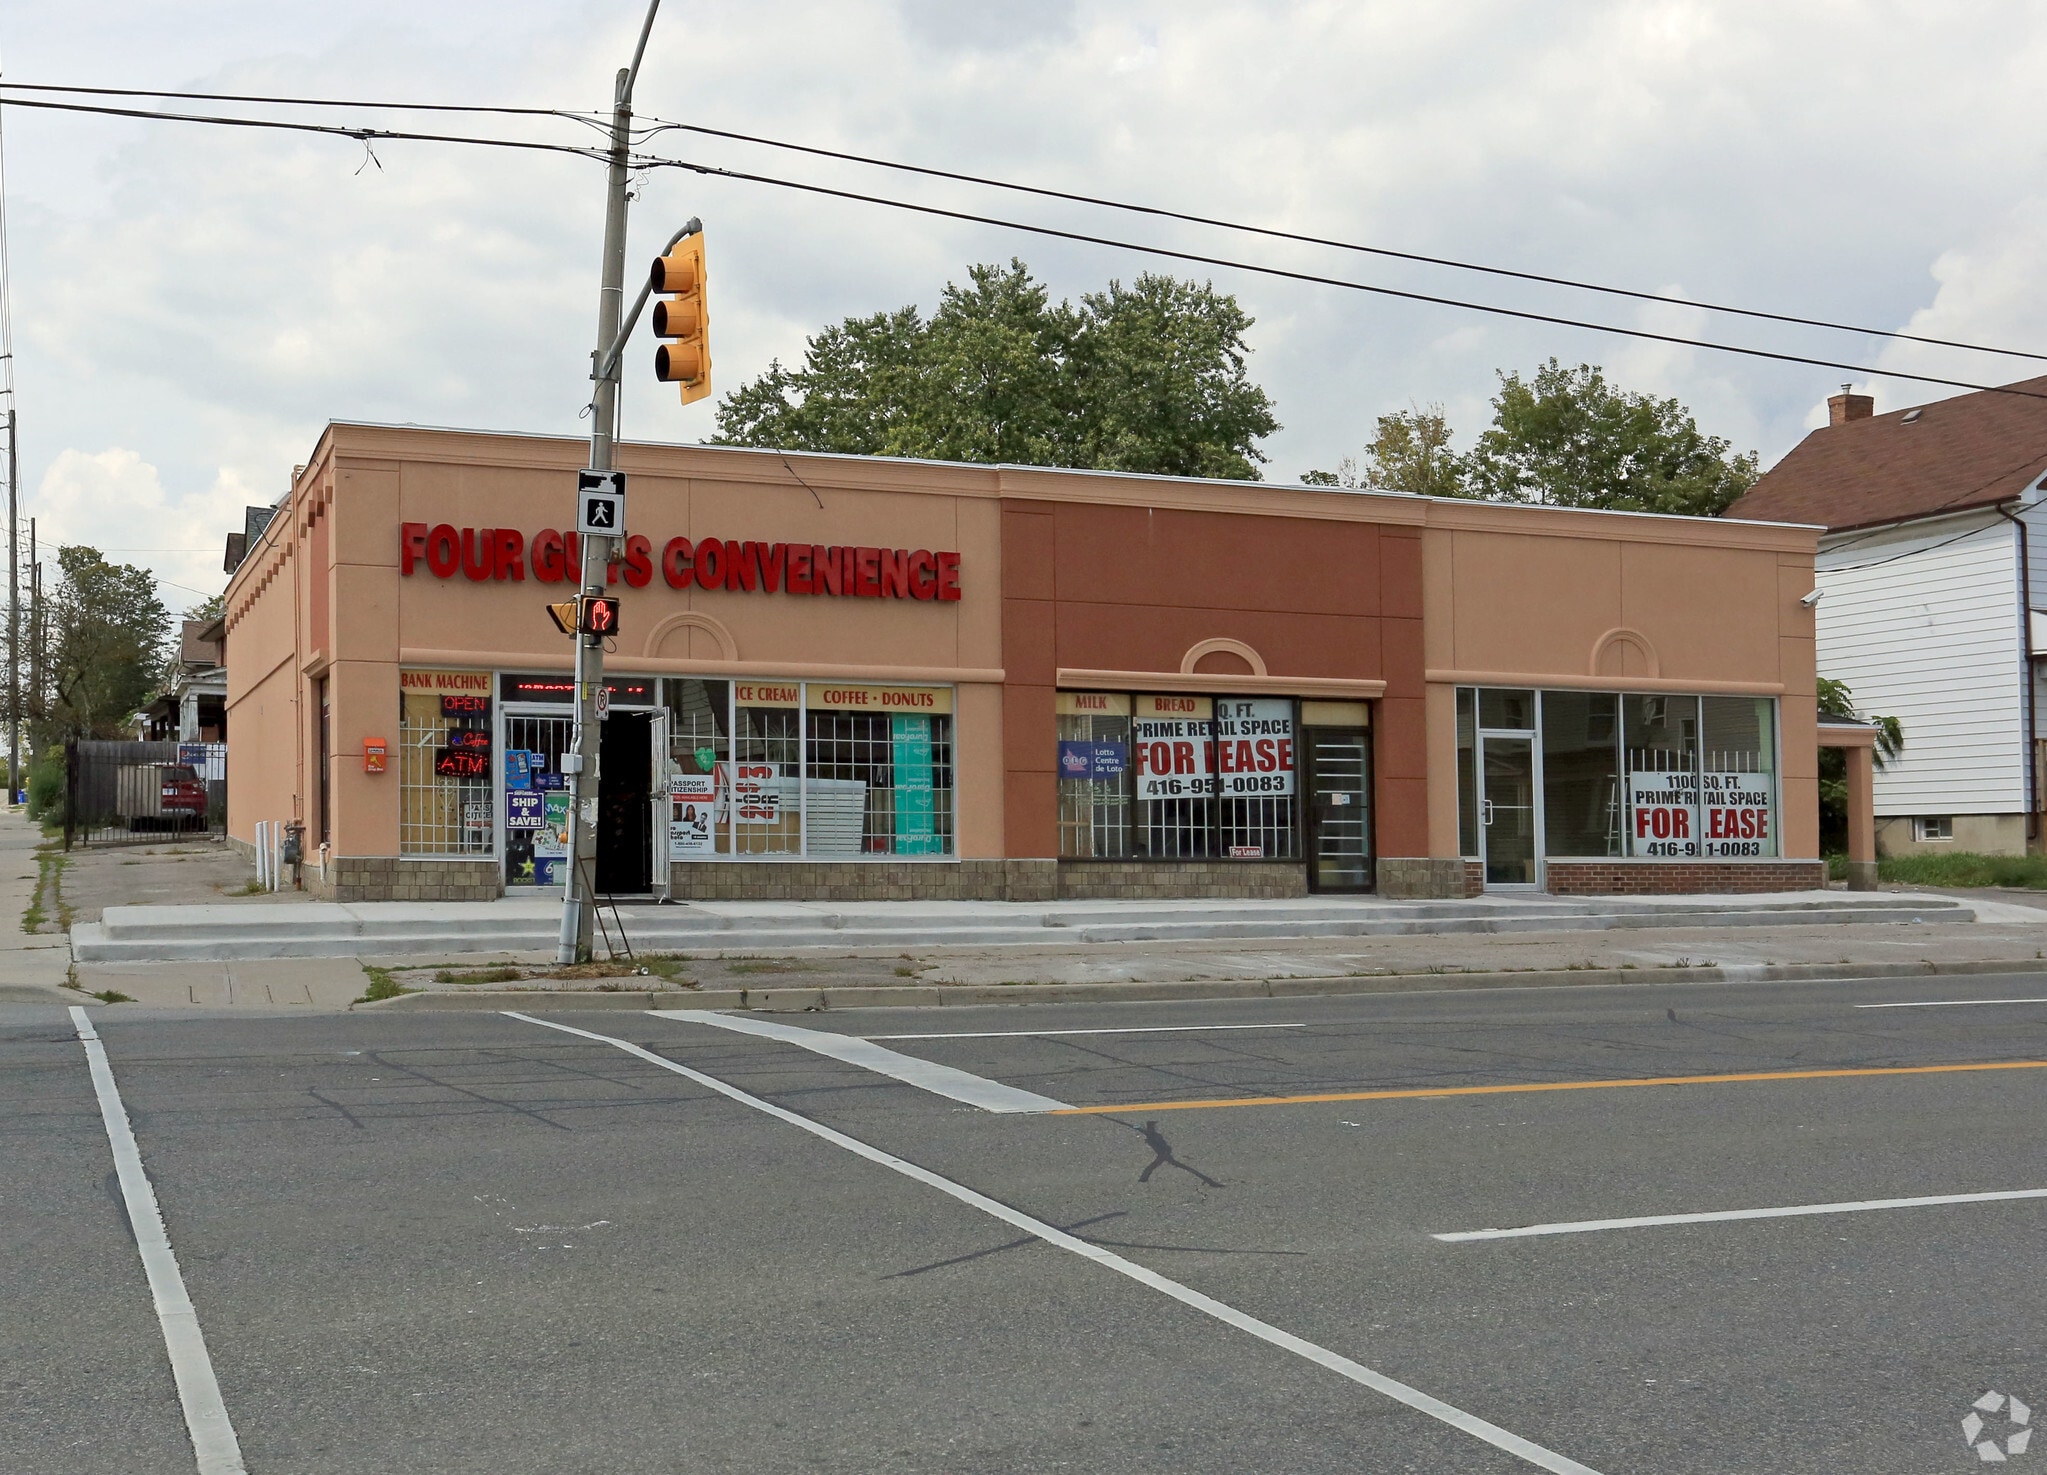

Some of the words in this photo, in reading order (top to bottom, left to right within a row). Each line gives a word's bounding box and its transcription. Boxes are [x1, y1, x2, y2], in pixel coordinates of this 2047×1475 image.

[401, 522, 525, 582] FOUR
[531, 528, 653, 589] GUS
[662, 536, 962, 601] CONVENIENCE
[401, 673, 432, 688] BANK
[436, 674, 488, 690] MACHINE
[735, 686, 754, 701] ICE
[758, 687, 798, 702] CREAM
[823, 690, 869, 705] COFFEE
[882, 692, 934, 707] DONUTS
[445, 696, 486, 711] OPEN
[1075, 695, 1107, 709] MILK
[1155, 697, 1196, 712] BREAD
[1236, 703, 1255, 718] FT.
[1241, 719, 1290, 736] SPACE
[463, 732, 489, 747] Coffee
[1095, 748, 1115, 756] Lotto
[1137, 741, 1195, 776] FOR
[441, 755, 483, 774] ATM
[1095, 757, 1120, 765] Centre
[1107, 765, 1123, 773] Loto
[1147, 776, 1285, 795] 416-951-0083
[1666, 775, 1697, 788] 1100
[1725, 776, 1741, 790] FT.
[512, 797, 539, 807] SHIP
[1636, 791, 1681, 805] PRIME
[1729, 792, 1767, 806] SPACE
[465, 811, 493, 819] CITIZE
[468, 804, 493, 812] PASS
[521, 807, 530, 816] &
[509, 816, 541, 826] SAVE!
[1636, 807, 1689, 838] FOR
[1704, 808, 1768, 839] EASE
[1231, 848, 1242, 857] For
[1243, 848, 1261, 857] Lease
[1647, 841, 1760, 857] 416-91-0083
